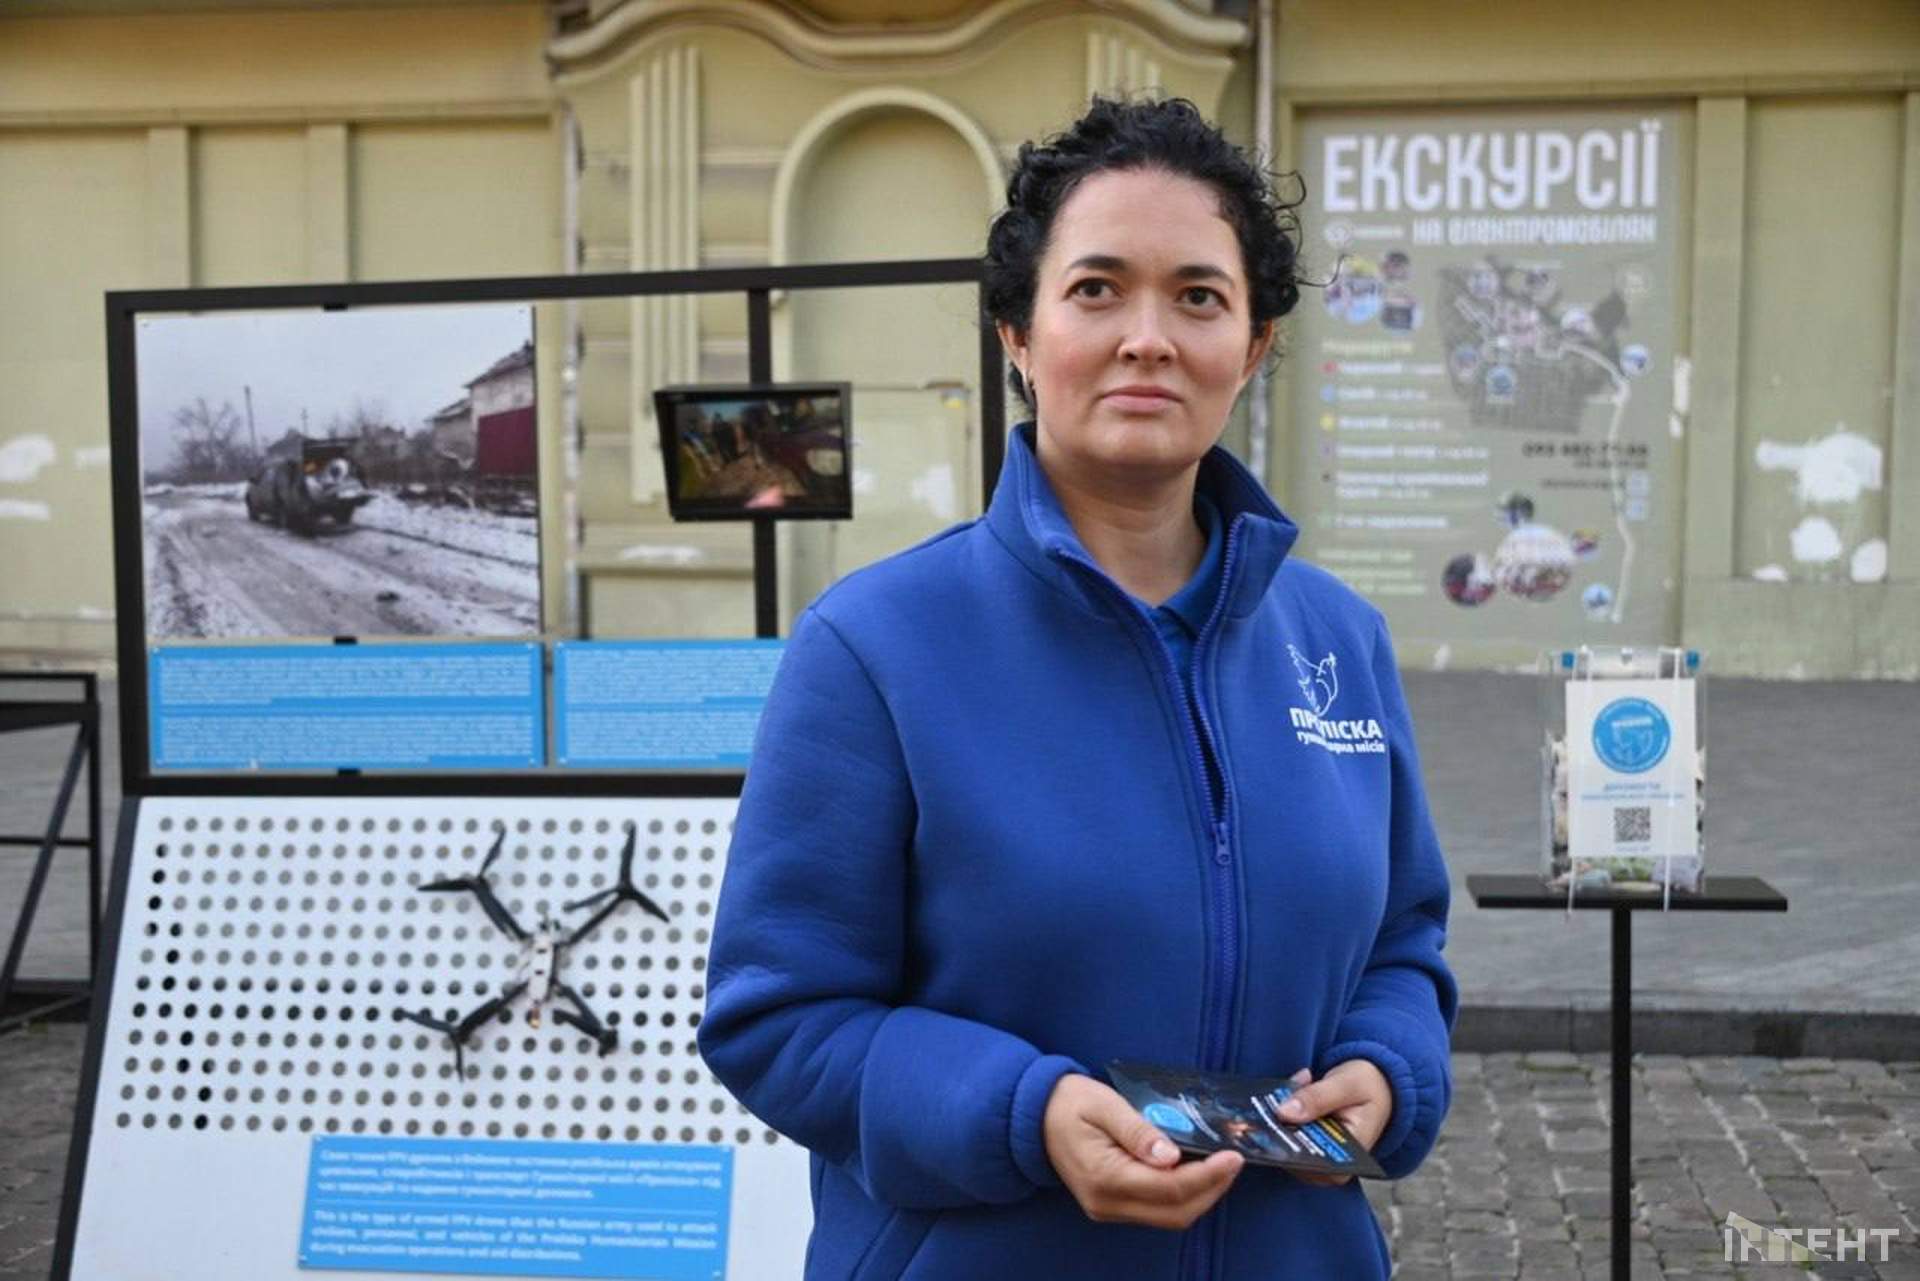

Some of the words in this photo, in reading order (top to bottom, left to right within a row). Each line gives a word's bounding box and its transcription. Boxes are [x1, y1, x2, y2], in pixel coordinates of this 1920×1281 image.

[1323, 119, 1661, 212] ЕКСКУРСІЇ
[1413, 217, 1443, 244] НА
[1289, 707, 1383, 739] ПРЛІСКА
